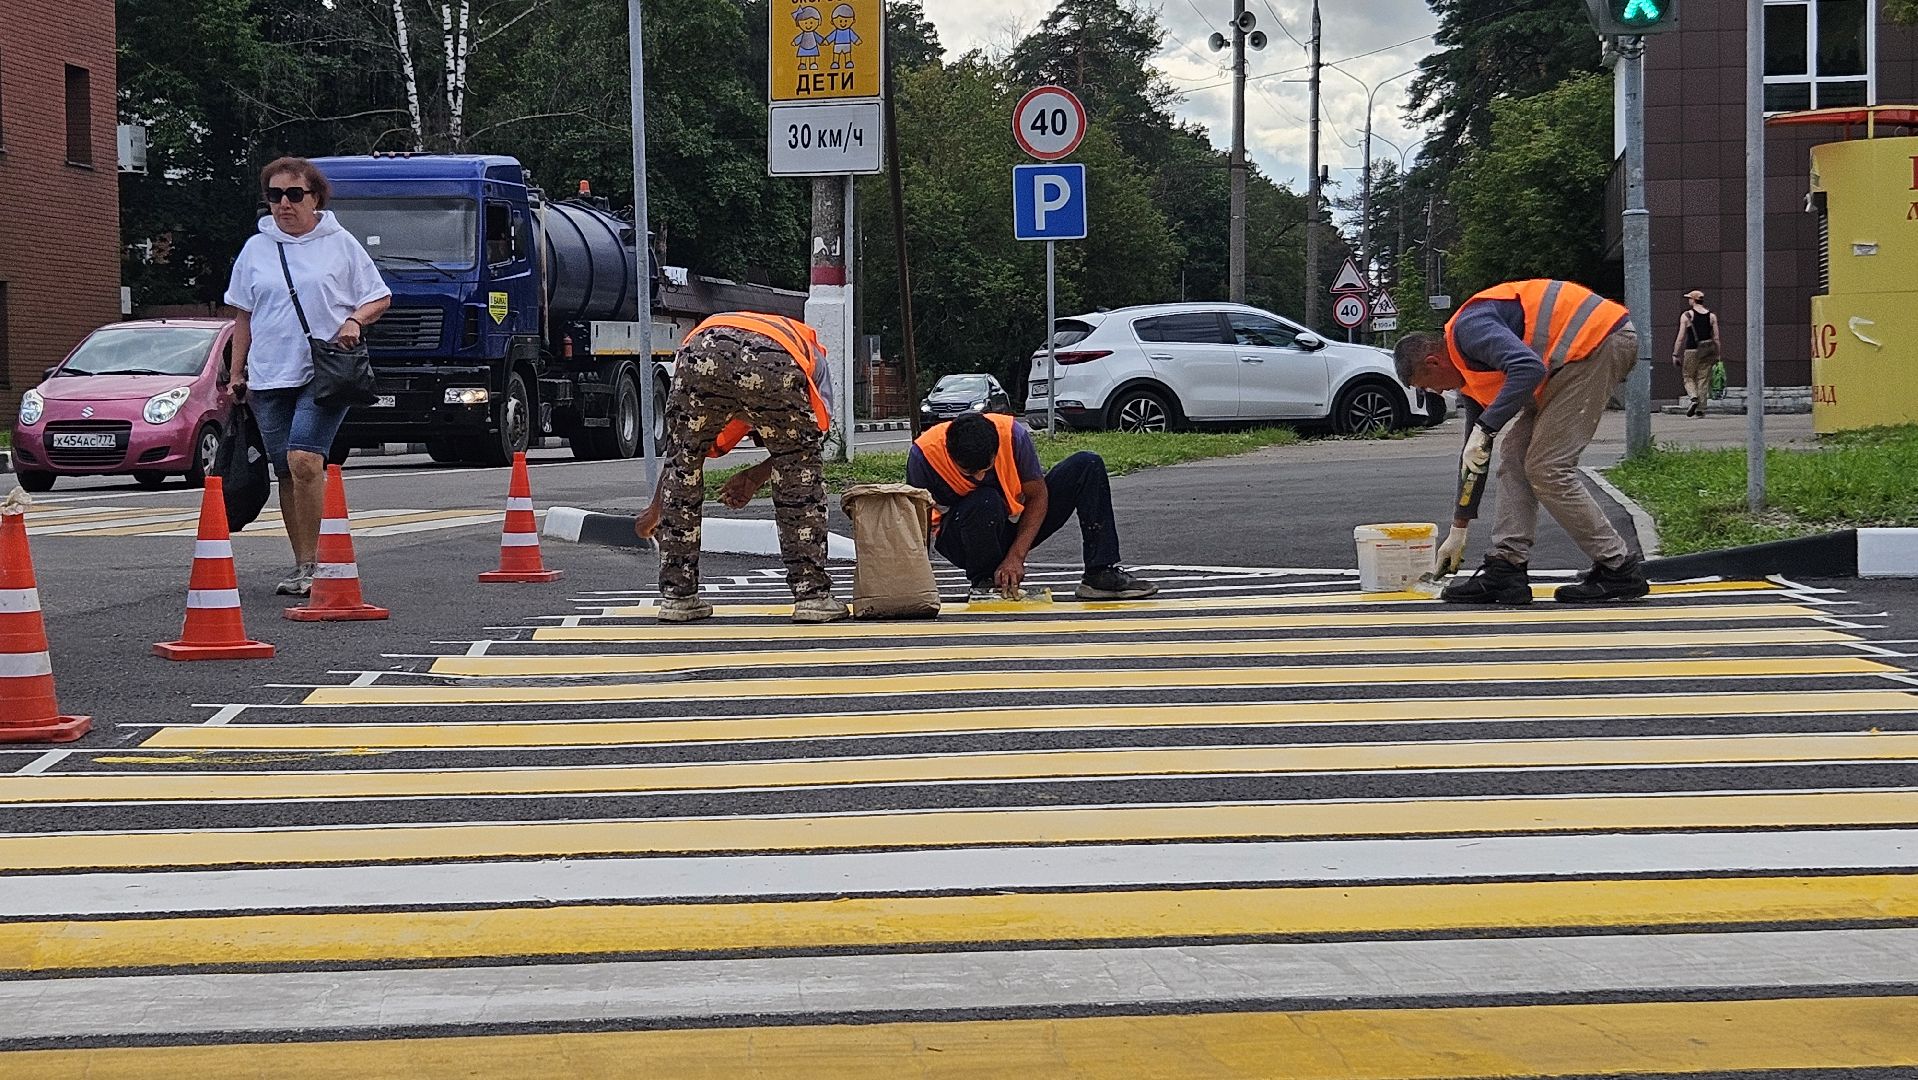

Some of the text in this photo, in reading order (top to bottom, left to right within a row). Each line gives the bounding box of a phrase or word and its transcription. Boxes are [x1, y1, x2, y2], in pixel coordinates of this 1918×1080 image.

[796, 72, 854, 95] ДЕТИ
[1030, 108, 1067, 136] 40
[788, 122, 863, 153] 30 км/ч
[1034, 175, 1071, 230] P
[1340, 304, 1359, 317] 40
[98, 434, 113, 444] 777
